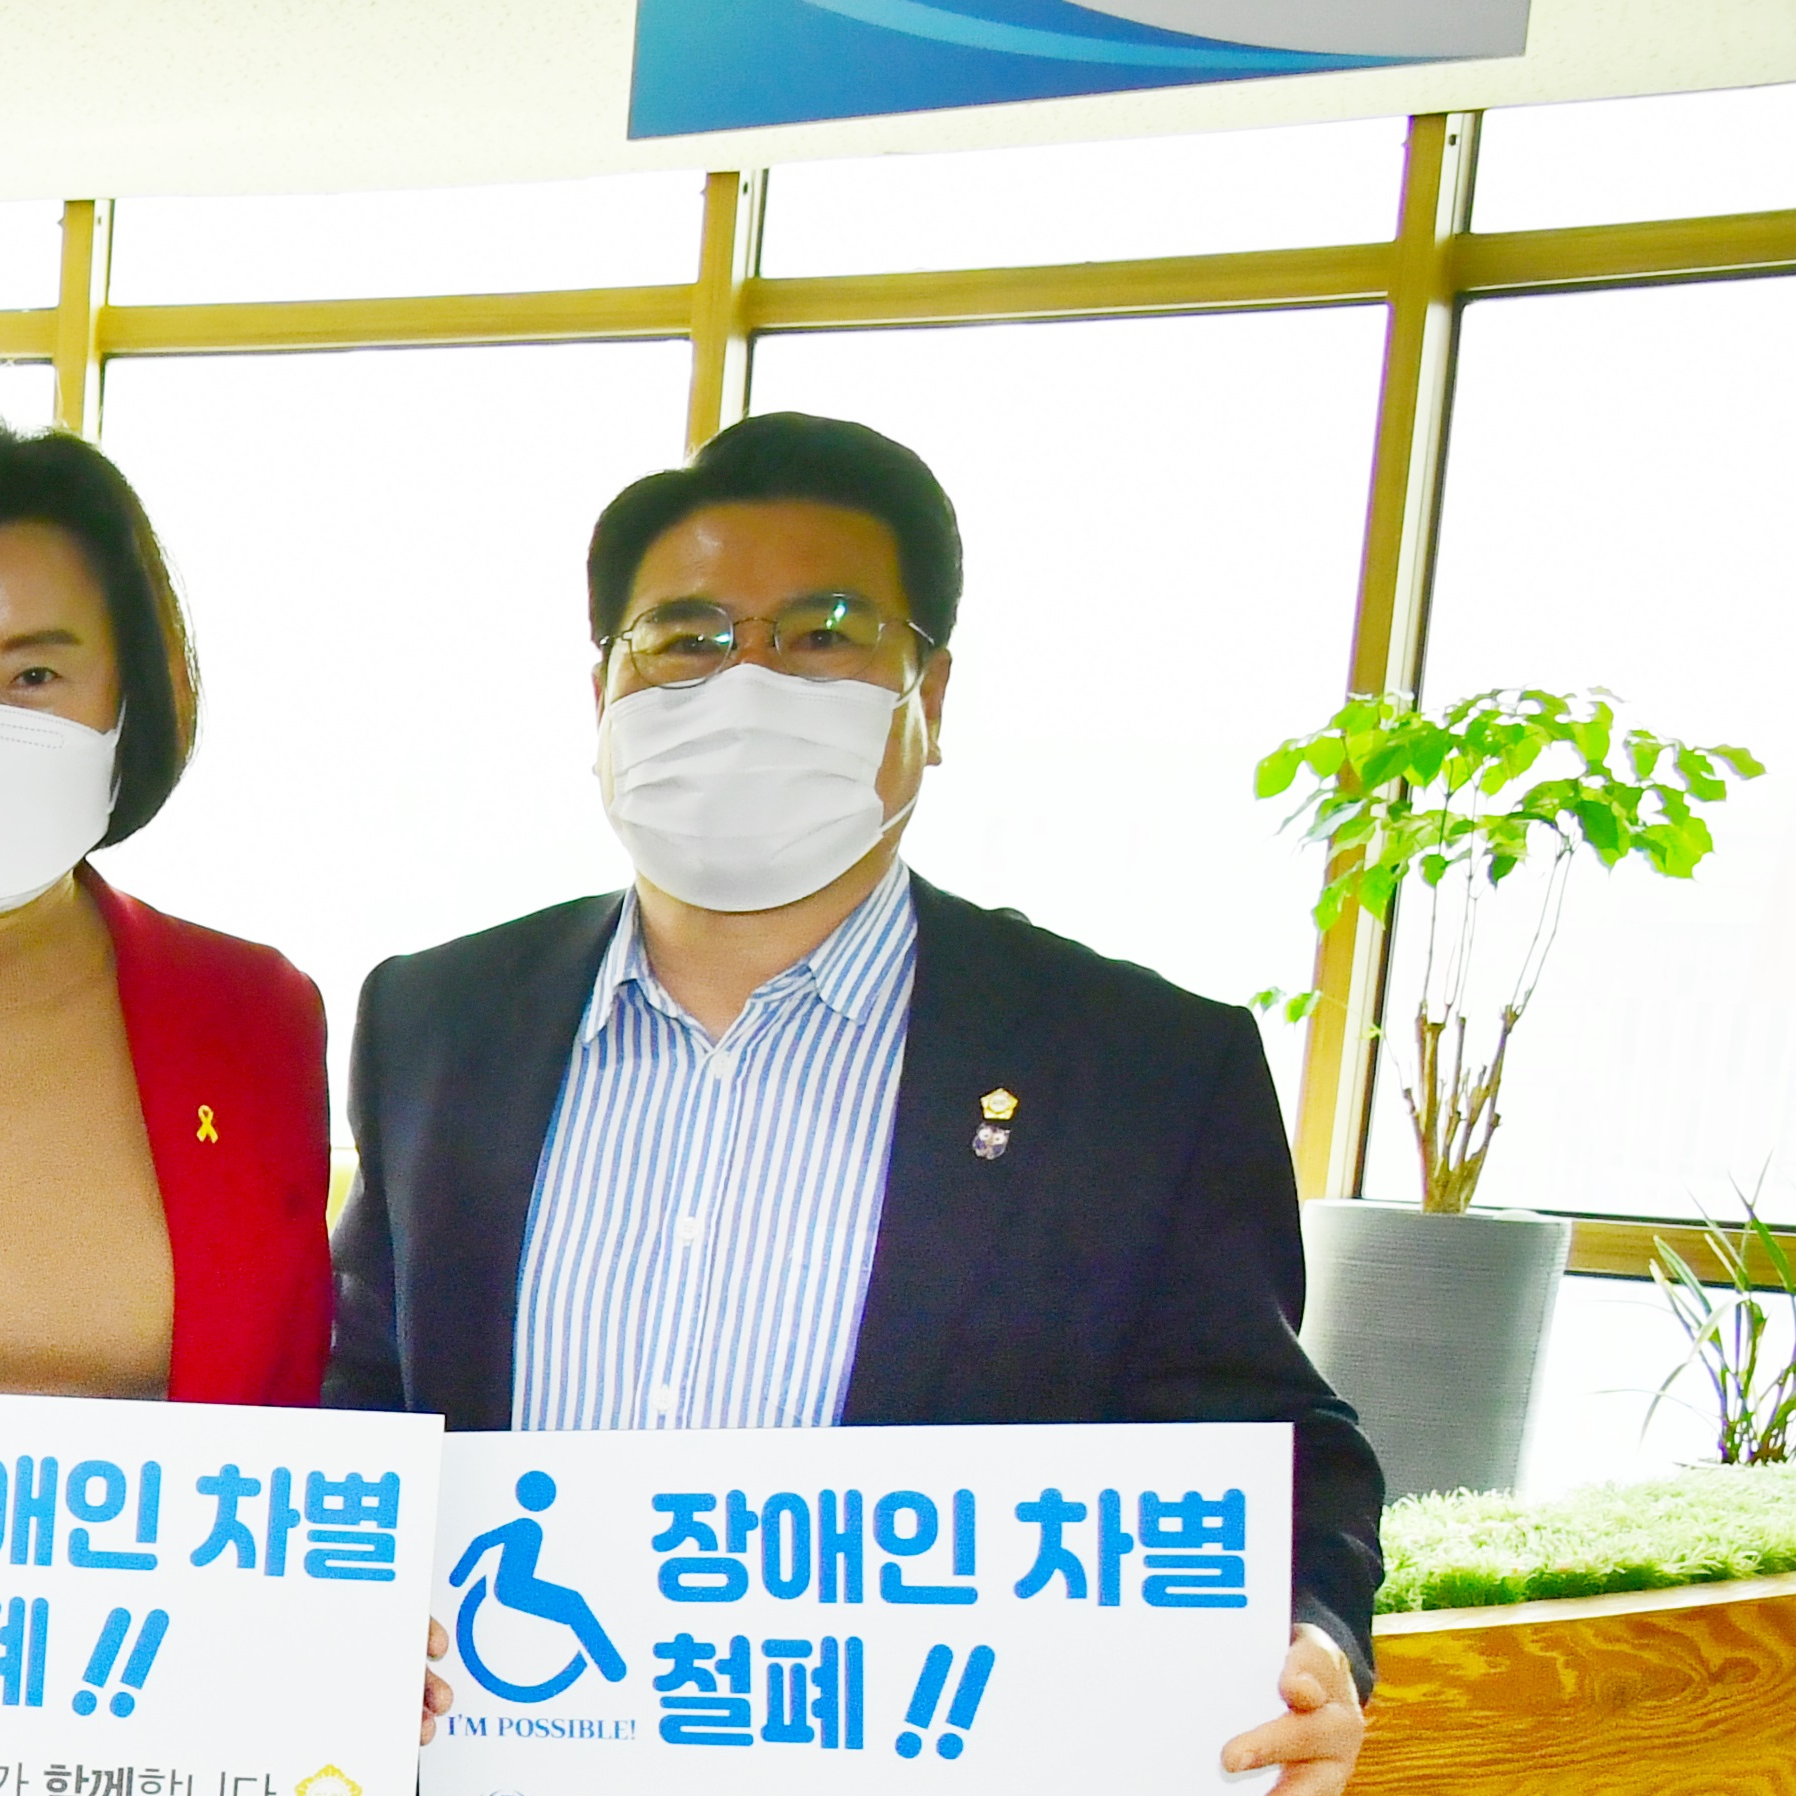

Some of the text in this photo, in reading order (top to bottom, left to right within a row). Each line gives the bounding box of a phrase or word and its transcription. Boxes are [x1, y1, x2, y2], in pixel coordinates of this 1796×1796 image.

[190, 1463, 401, 1583] 차별
[651, 1487, 1248, 1609] 장애인 차별
[72, 1607, 170, 1719] !!
[652, 1632, 996, 1760] 철폐 !!
[447, 1715, 637, 1741] I'M POSSIBLE!
